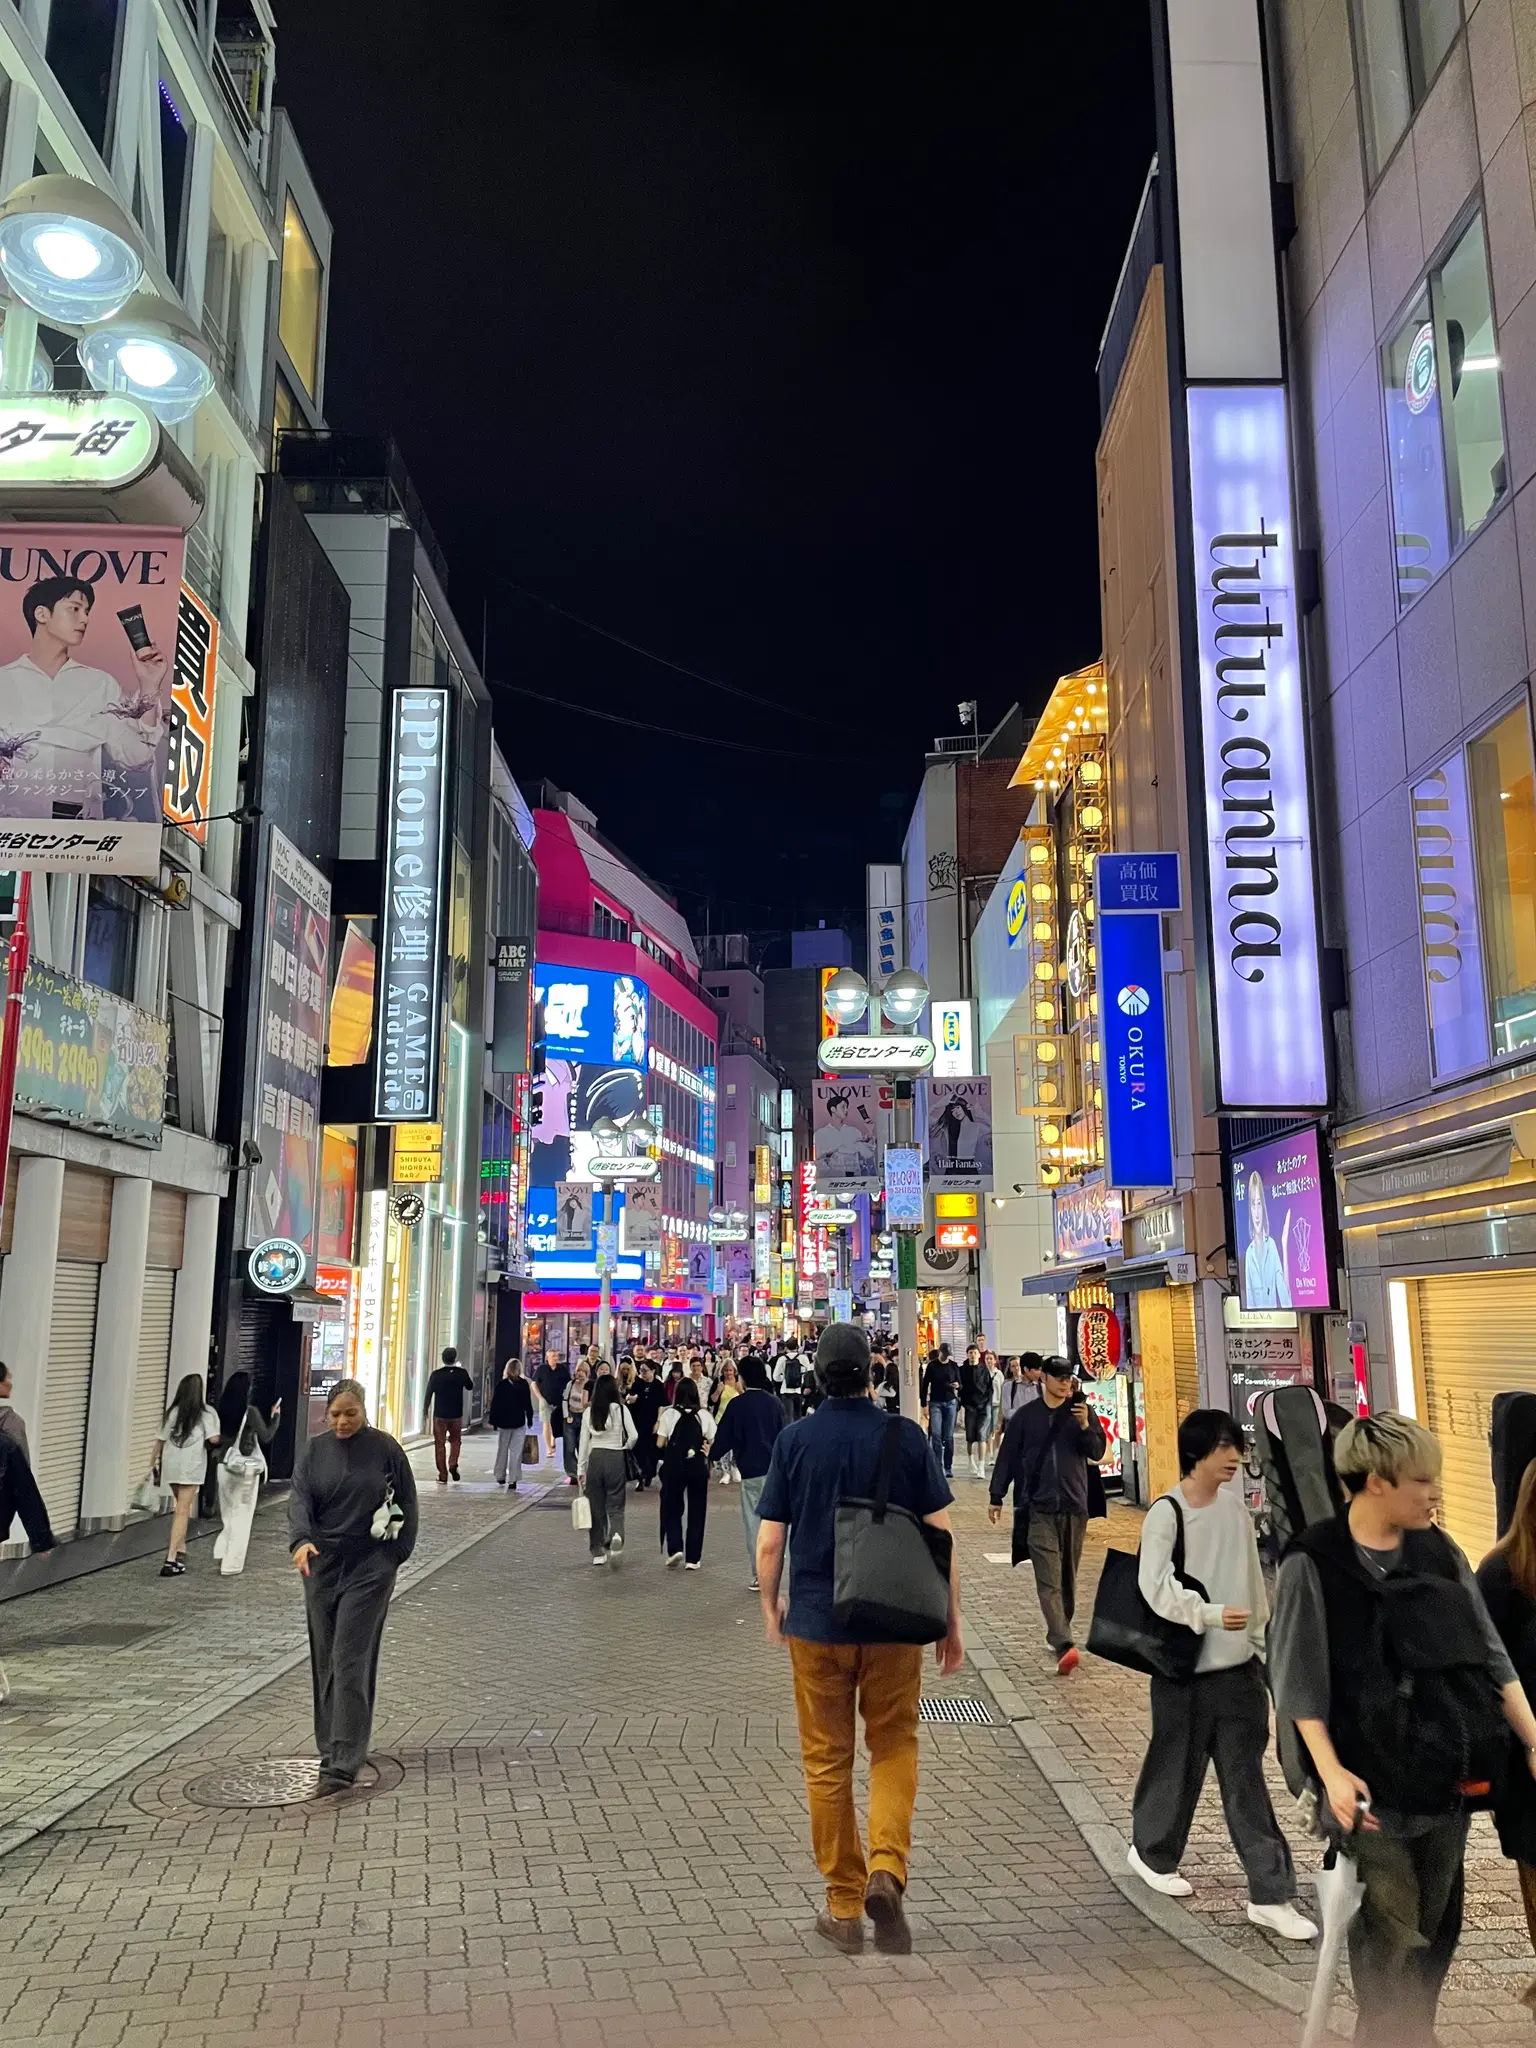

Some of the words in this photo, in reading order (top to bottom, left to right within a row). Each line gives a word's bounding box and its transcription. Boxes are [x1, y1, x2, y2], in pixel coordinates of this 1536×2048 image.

[0, 548, 168, 585] UNOVE
[1119, 861, 1157, 880] 高価
[1120, 884, 1159, 902] 買取
[1008, 888, 1026, 929] IKEA
[498, 945, 526, 958] ABC
[498, 958, 526, 968] MART
[270, 939, 322, 1015] 即日修理
[384, 983, 406, 1094] Android
[403, 982, 429, 1084] GAME
[947, 1015, 955, 1047] IKEA
[266, 1010, 320, 1078] 格安販売
[825, 1045, 929, 1059] 渋谷センター街
[1119, 1055, 1127, 1084] TOKYO
[1128, 1026, 1146, 1112] OKURA
[817, 1084, 872, 1100] UNOVE
[932, 1082, 988, 1097] UNOVE
[591, 1161, 653, 1171] 渋谷センター街
[955, 1158, 983, 1170] Fantasy
[558, 1186, 589, 1195] UNOVE
[626, 1186, 660, 1195] UNOVE
[1235, 1178, 1245, 1201] 4F
[1140, 1210, 1171, 1240] OKURA
[362, 1299, 376, 1331] BAR
[1089, 1311, 1108, 1369] 備長炭火焼
[1232, 1373, 1244, 1385] 3F
